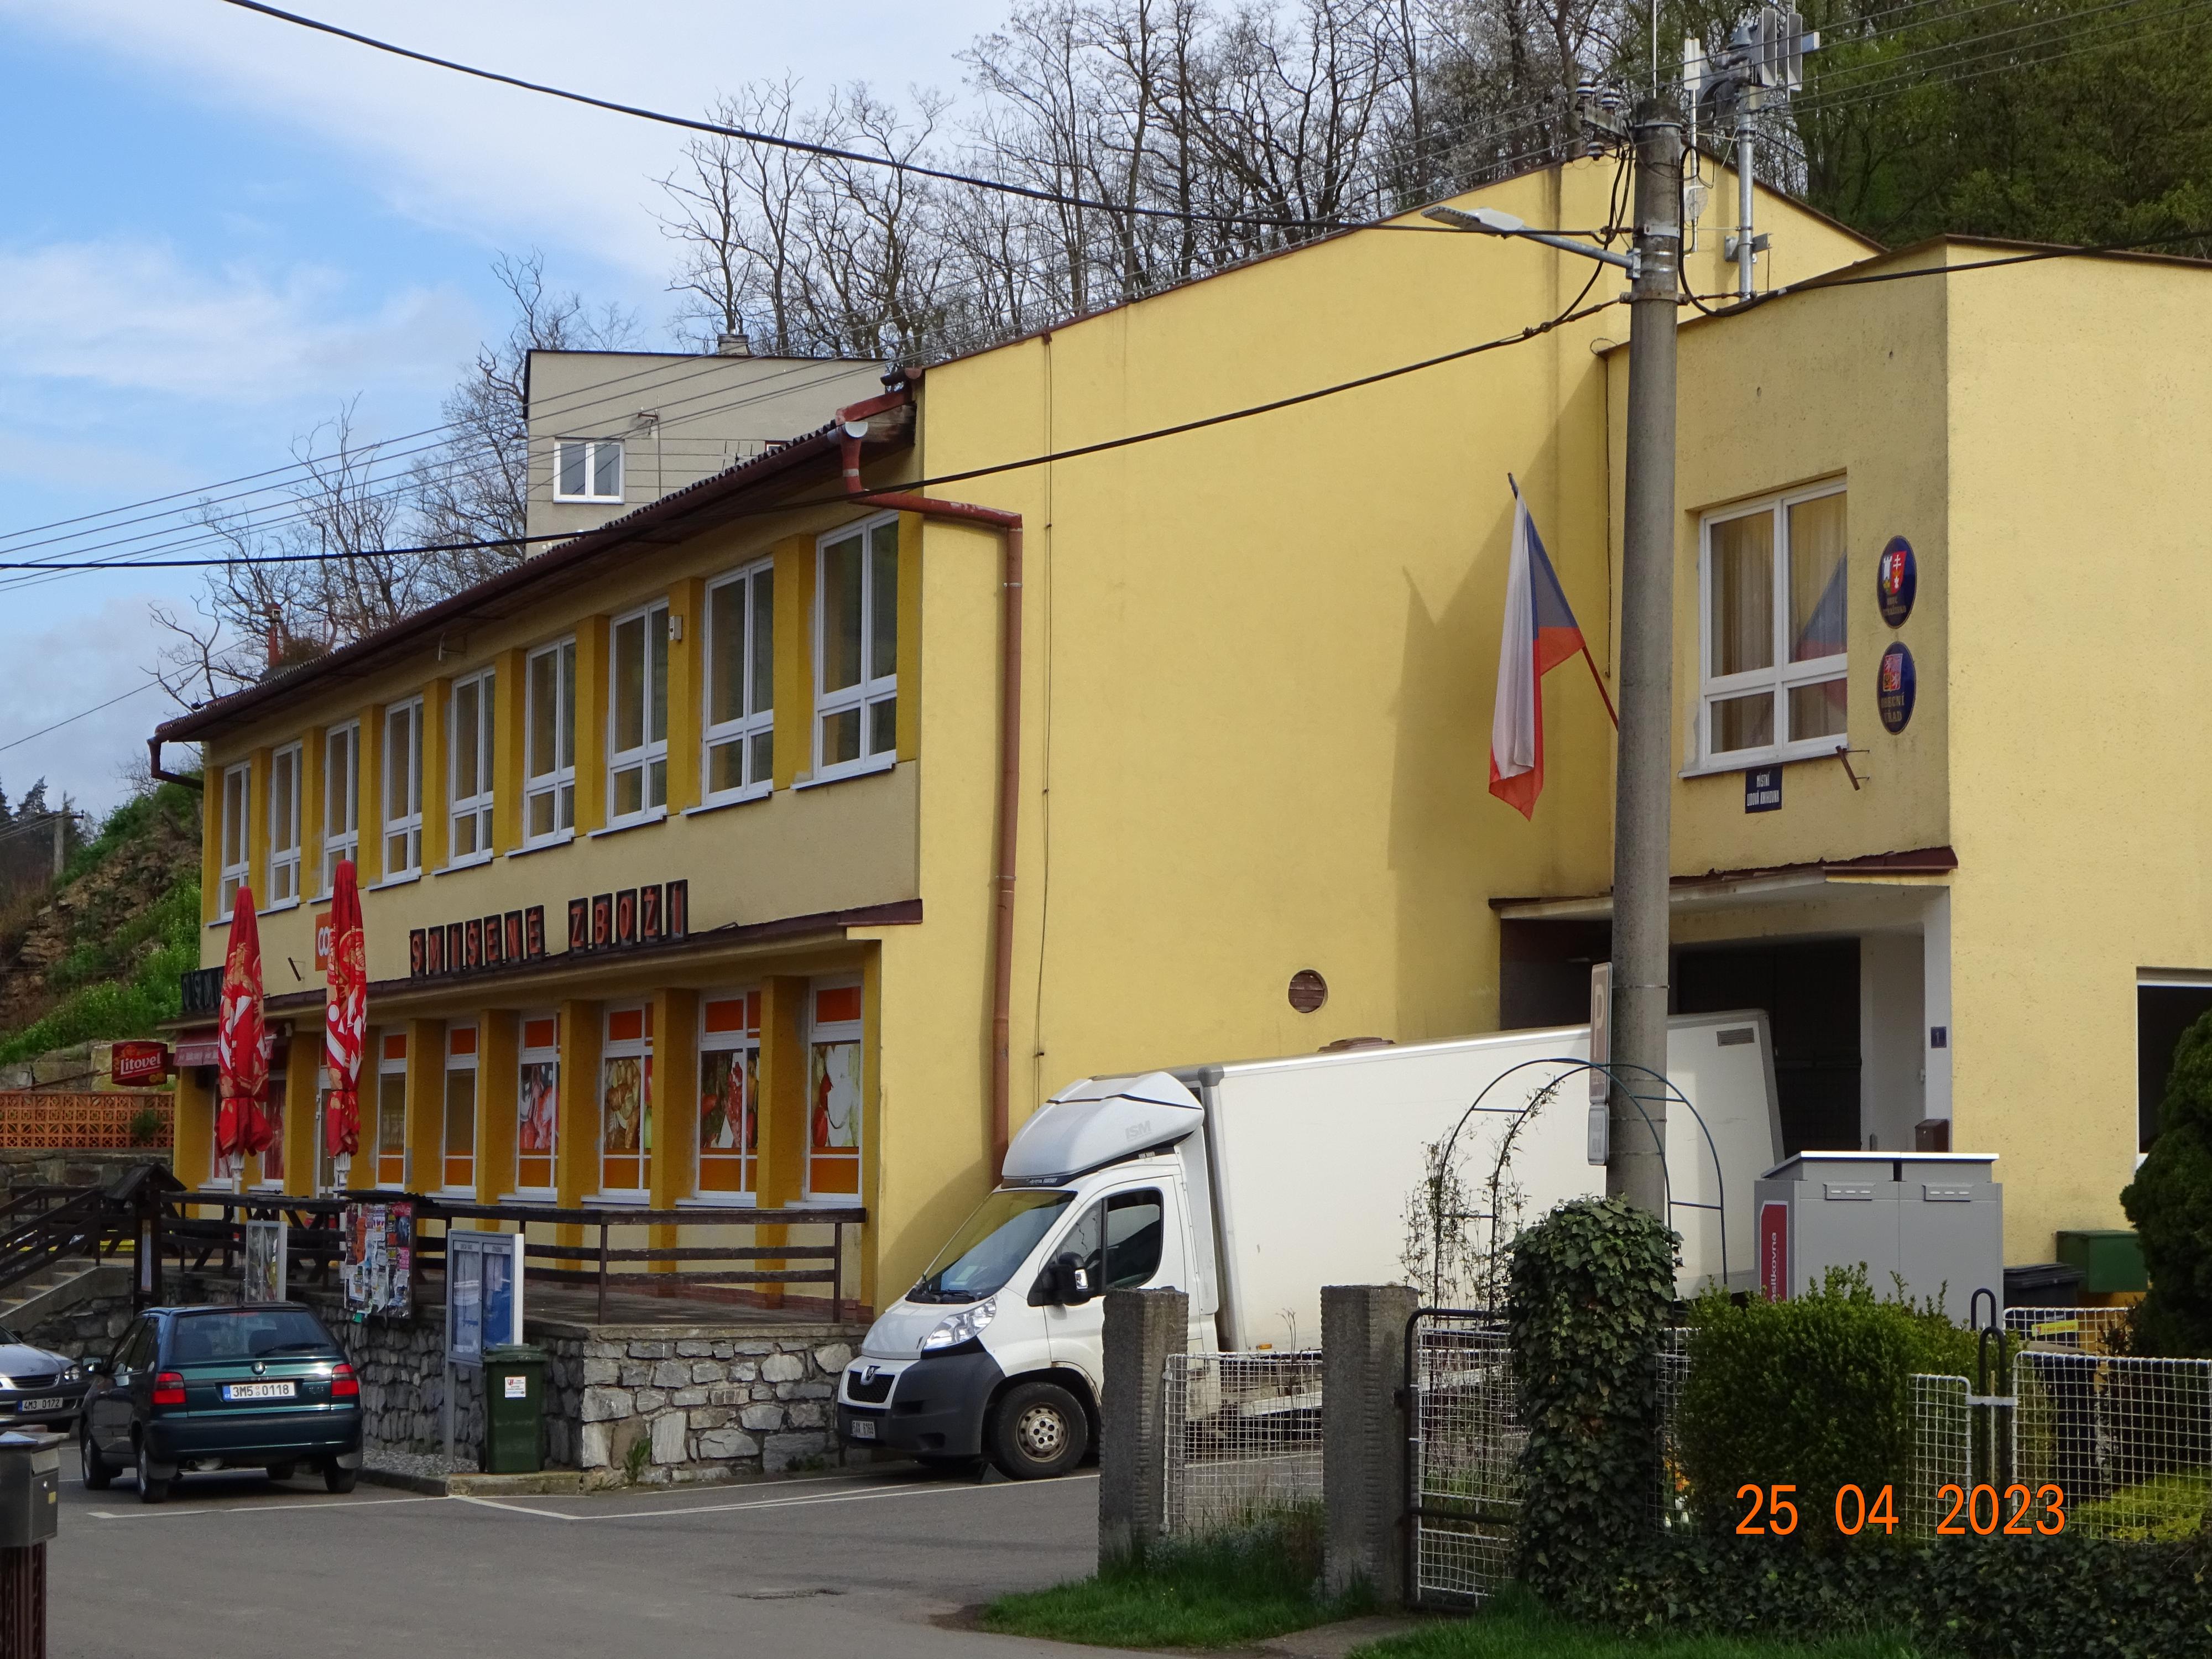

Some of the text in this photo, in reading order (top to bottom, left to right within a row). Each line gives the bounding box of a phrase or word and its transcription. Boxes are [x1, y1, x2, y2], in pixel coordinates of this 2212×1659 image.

[413, 884, 682, 972] SMÍŠENÉ ZBOŽÍ
[119, 1052, 161, 1076] Litovel
[233, 1384, 289, 1397] 3M5 0118
[24, 1399, 60, 1410] 4M3 0172
